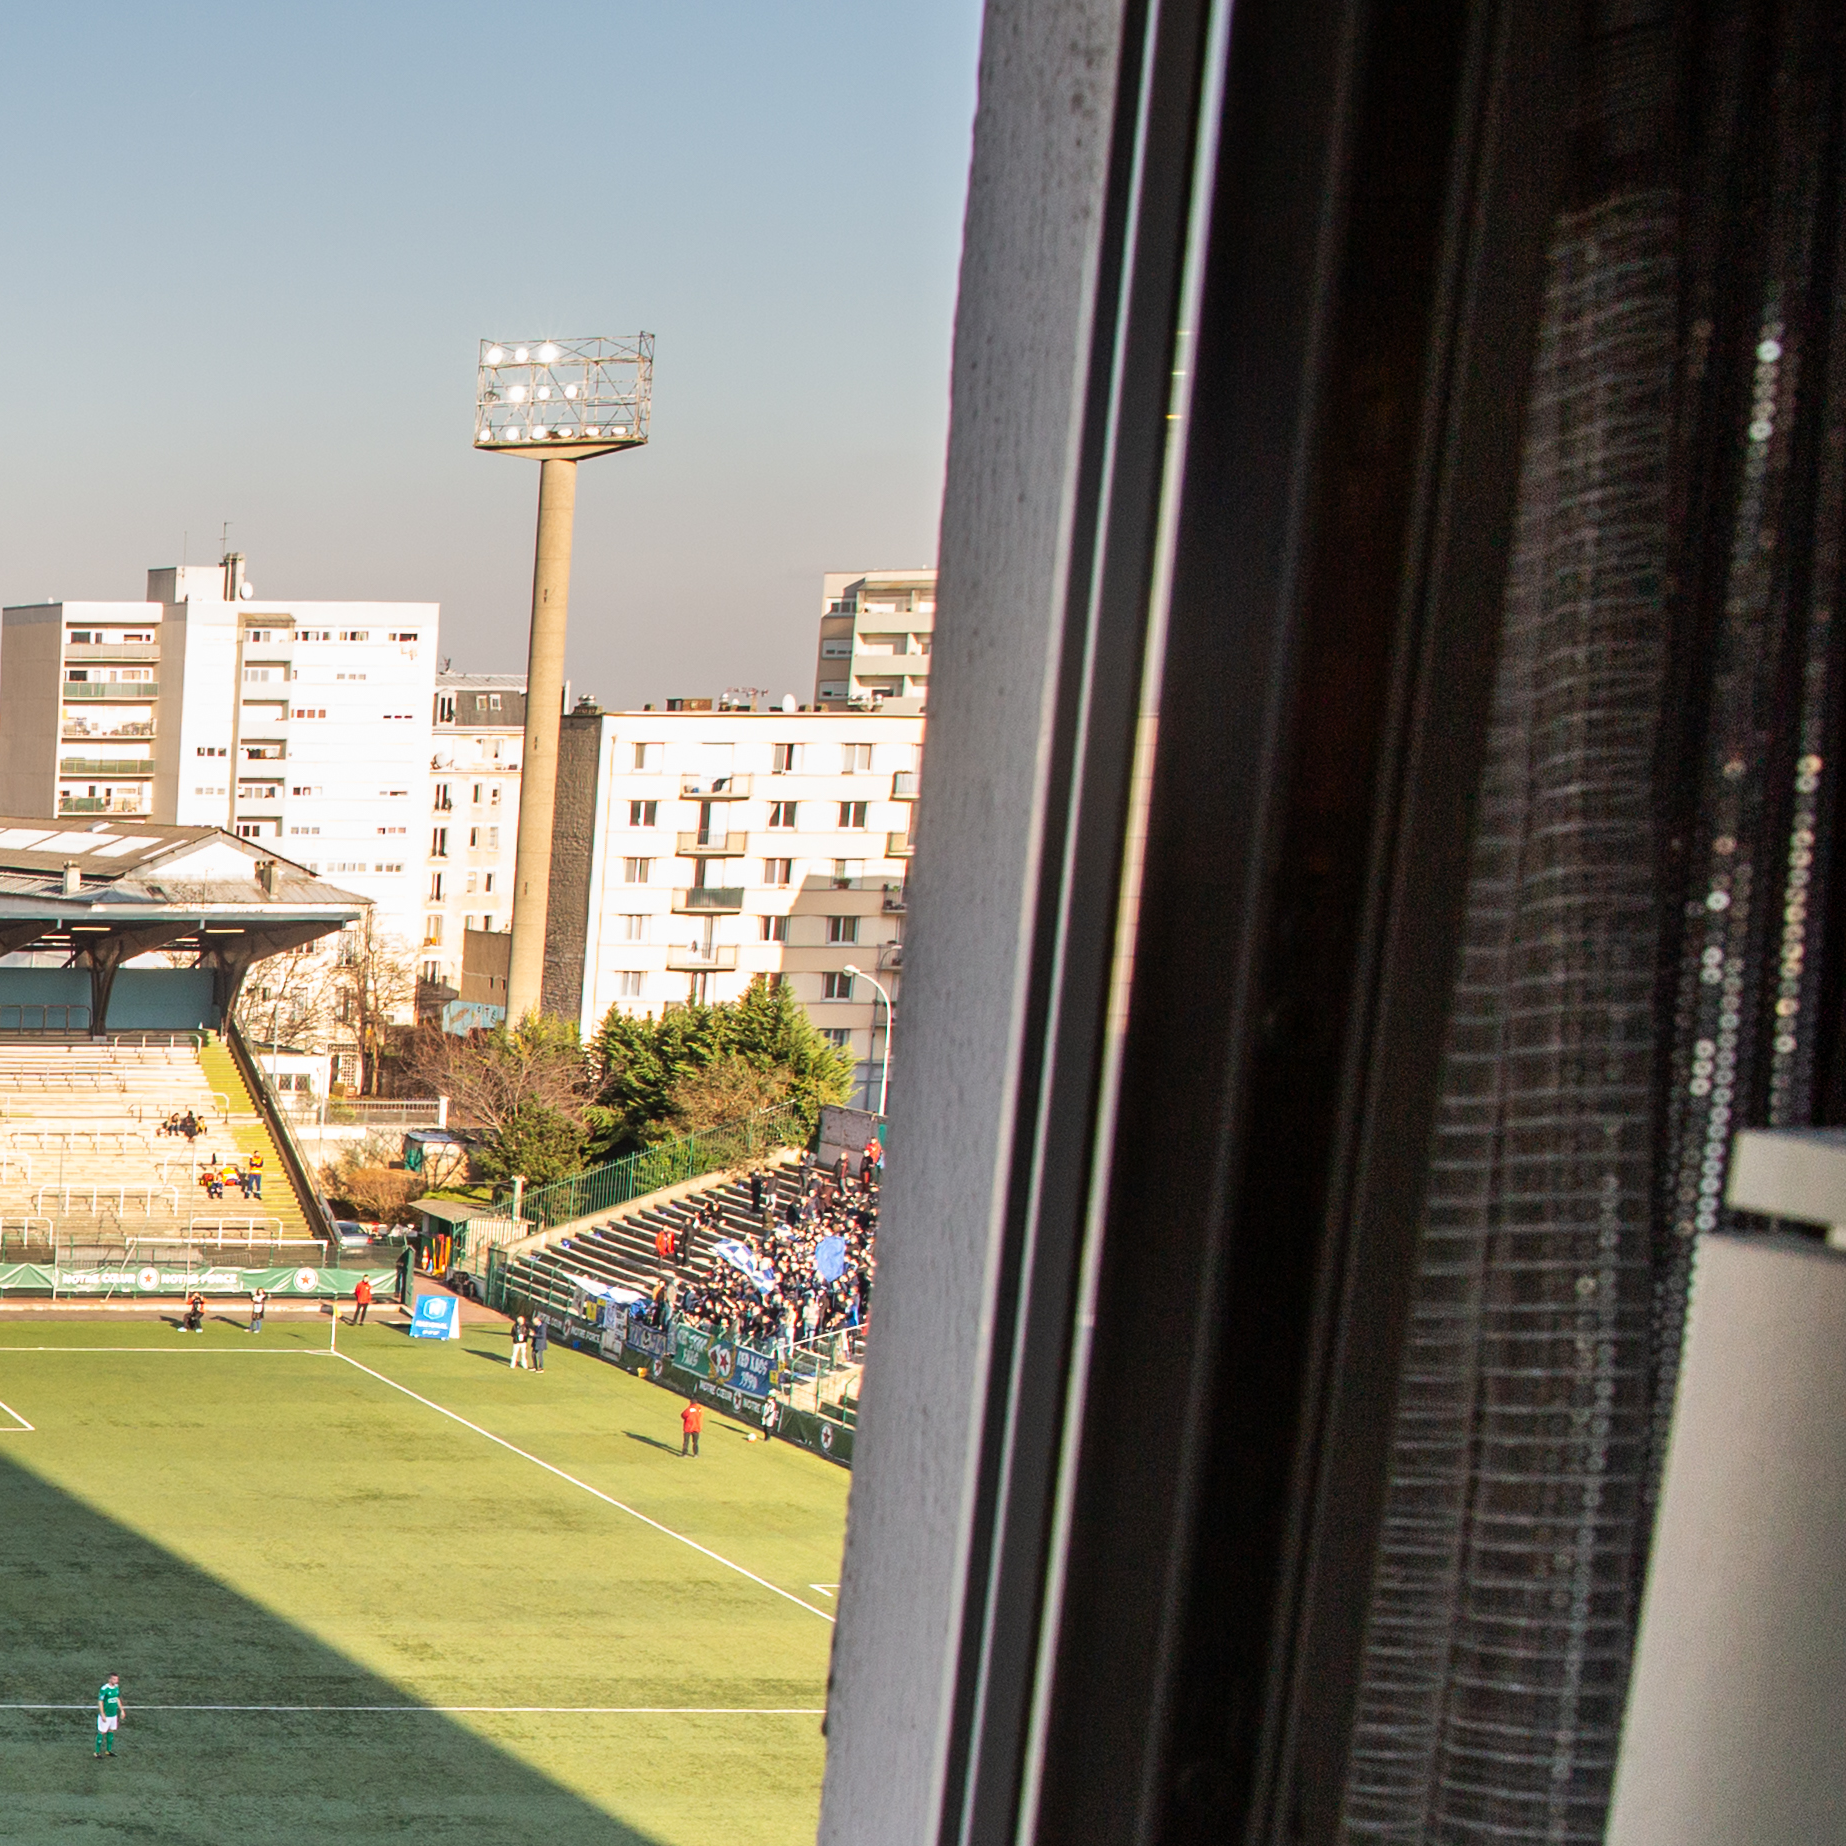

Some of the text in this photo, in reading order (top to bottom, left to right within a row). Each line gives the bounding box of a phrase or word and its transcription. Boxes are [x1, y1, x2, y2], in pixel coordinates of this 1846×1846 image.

[62, 1273, 99, 1284] NOTRE
[161, 1273, 237, 1284] NOTRE FORCE
[699, 1380, 716, 1395] NOTRE
[743, 1398, 761, 1414] NOTRE
